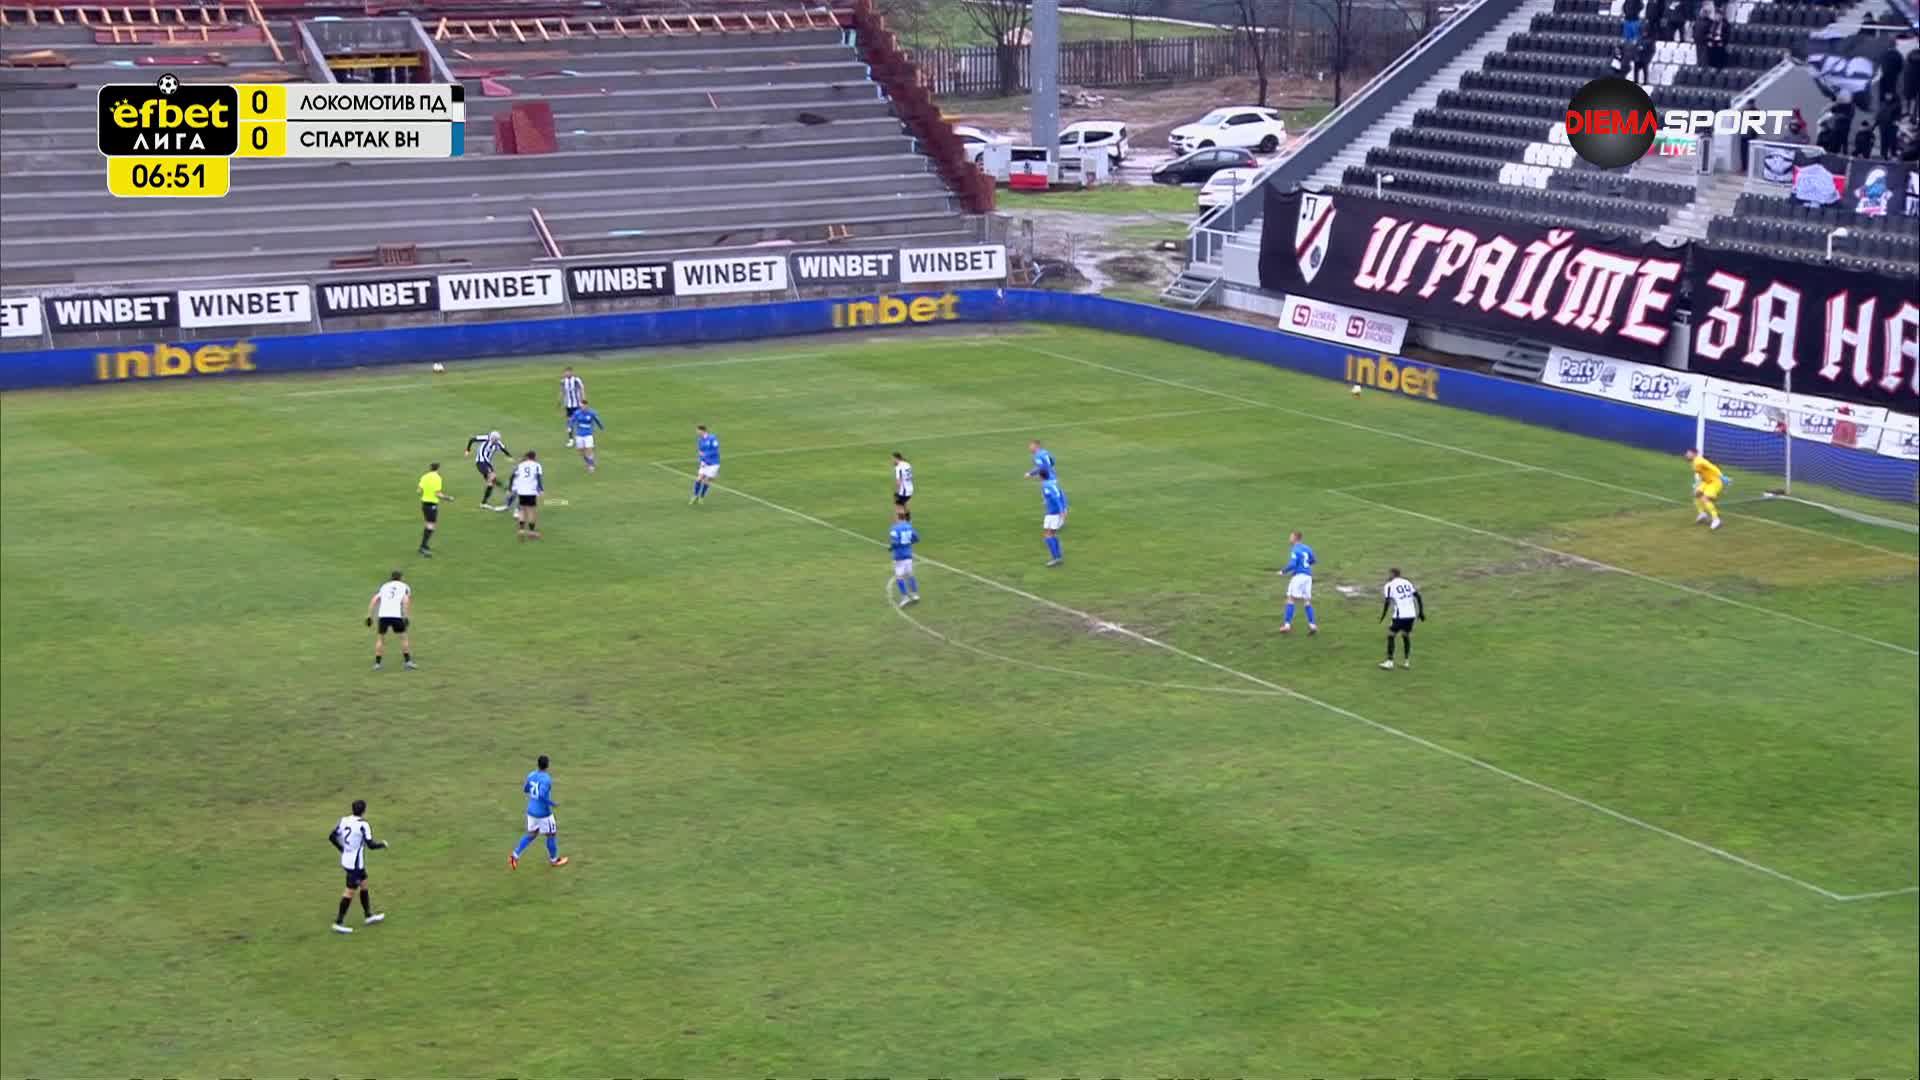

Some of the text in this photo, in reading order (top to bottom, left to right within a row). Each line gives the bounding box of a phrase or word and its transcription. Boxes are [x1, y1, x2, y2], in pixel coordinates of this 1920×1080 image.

[683, 260, 779, 287] WINBET
[798, 253, 893, 279] WINBET
[908, 249, 998, 274] WINBET
[449, 273, 552, 301] WINBET
[573, 266, 668, 294] WINBET
[1352, 215, 1683, 346] ИГРАЙТЕ
[190, 290, 300, 319] WINBET
[324, 280, 432, 310] WINBET
[54, 296, 170, 325] WINBET
[1694, 270, 1801, 373] ЗА
[1559, 356, 1604, 380] Party
[1630, 371, 1678, 397] Party
[1395, 584, 1411, 596] 99
[344, 826, 352, 843] 2
